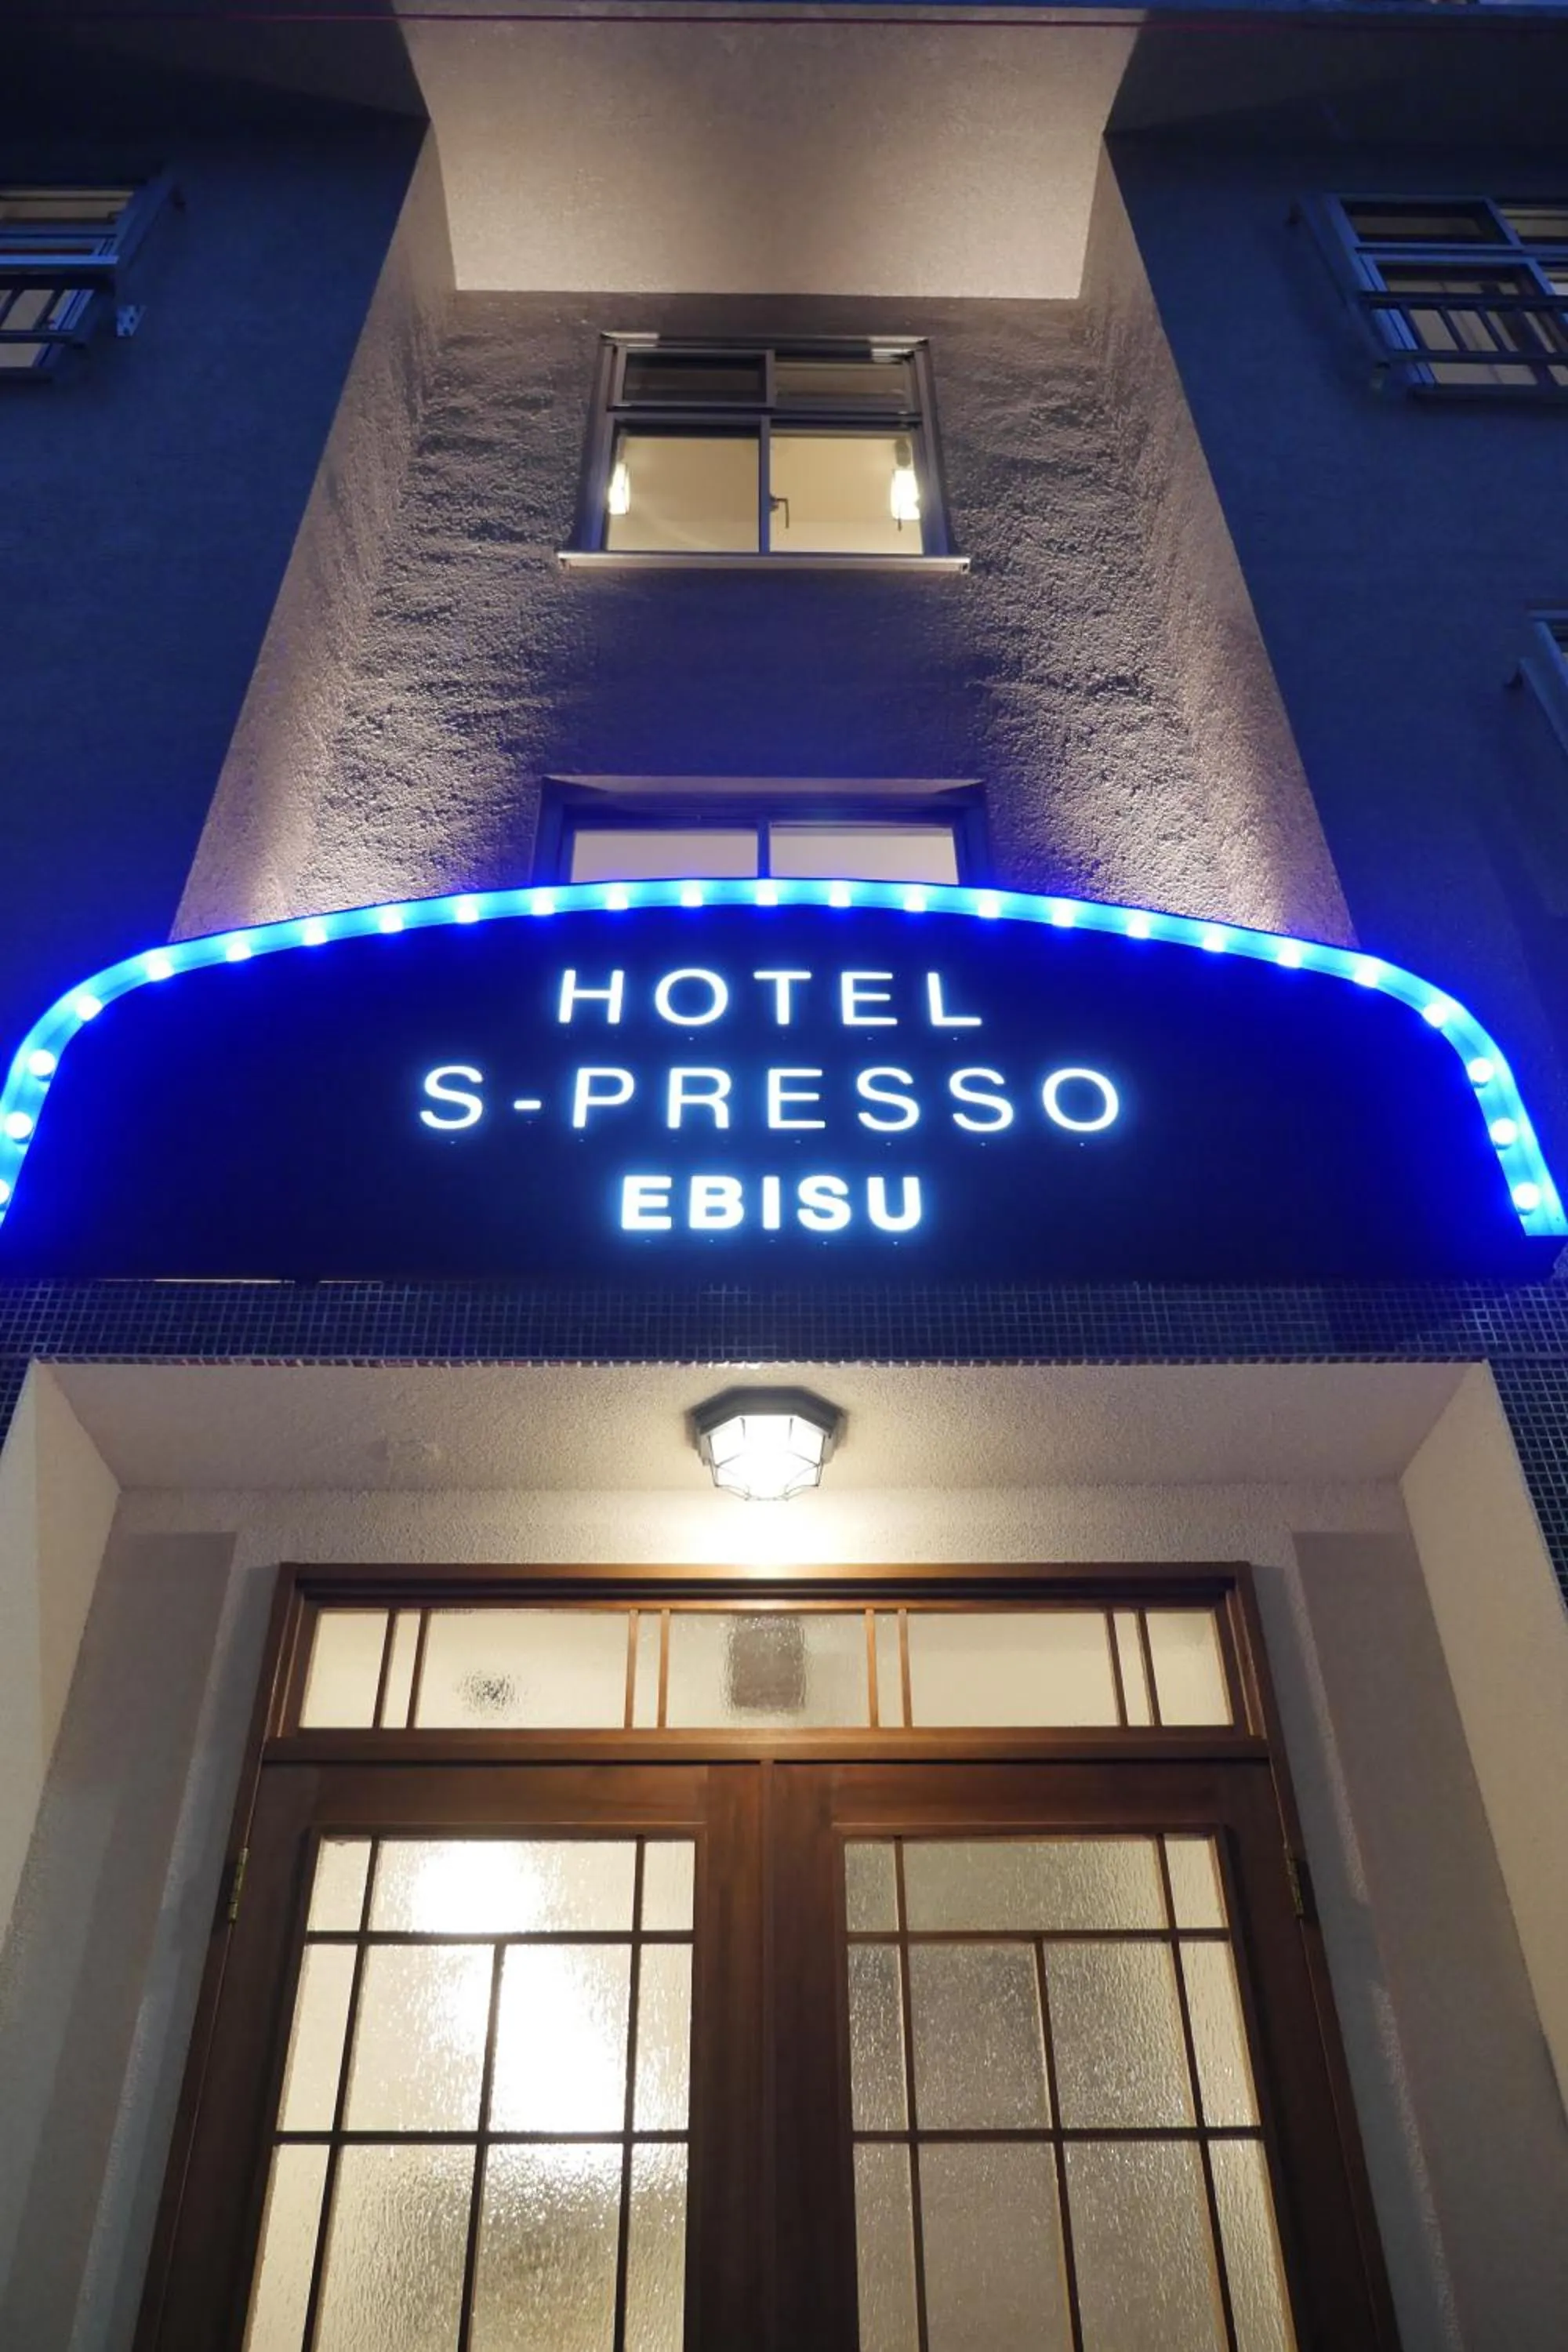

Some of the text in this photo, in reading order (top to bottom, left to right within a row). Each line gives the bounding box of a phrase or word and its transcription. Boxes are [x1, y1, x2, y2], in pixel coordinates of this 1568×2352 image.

[557, 968, 982, 1027] HOTEL
[419, 1065, 1120, 1133] S-PRESSO
[619, 1174, 923, 1232] EBISU
